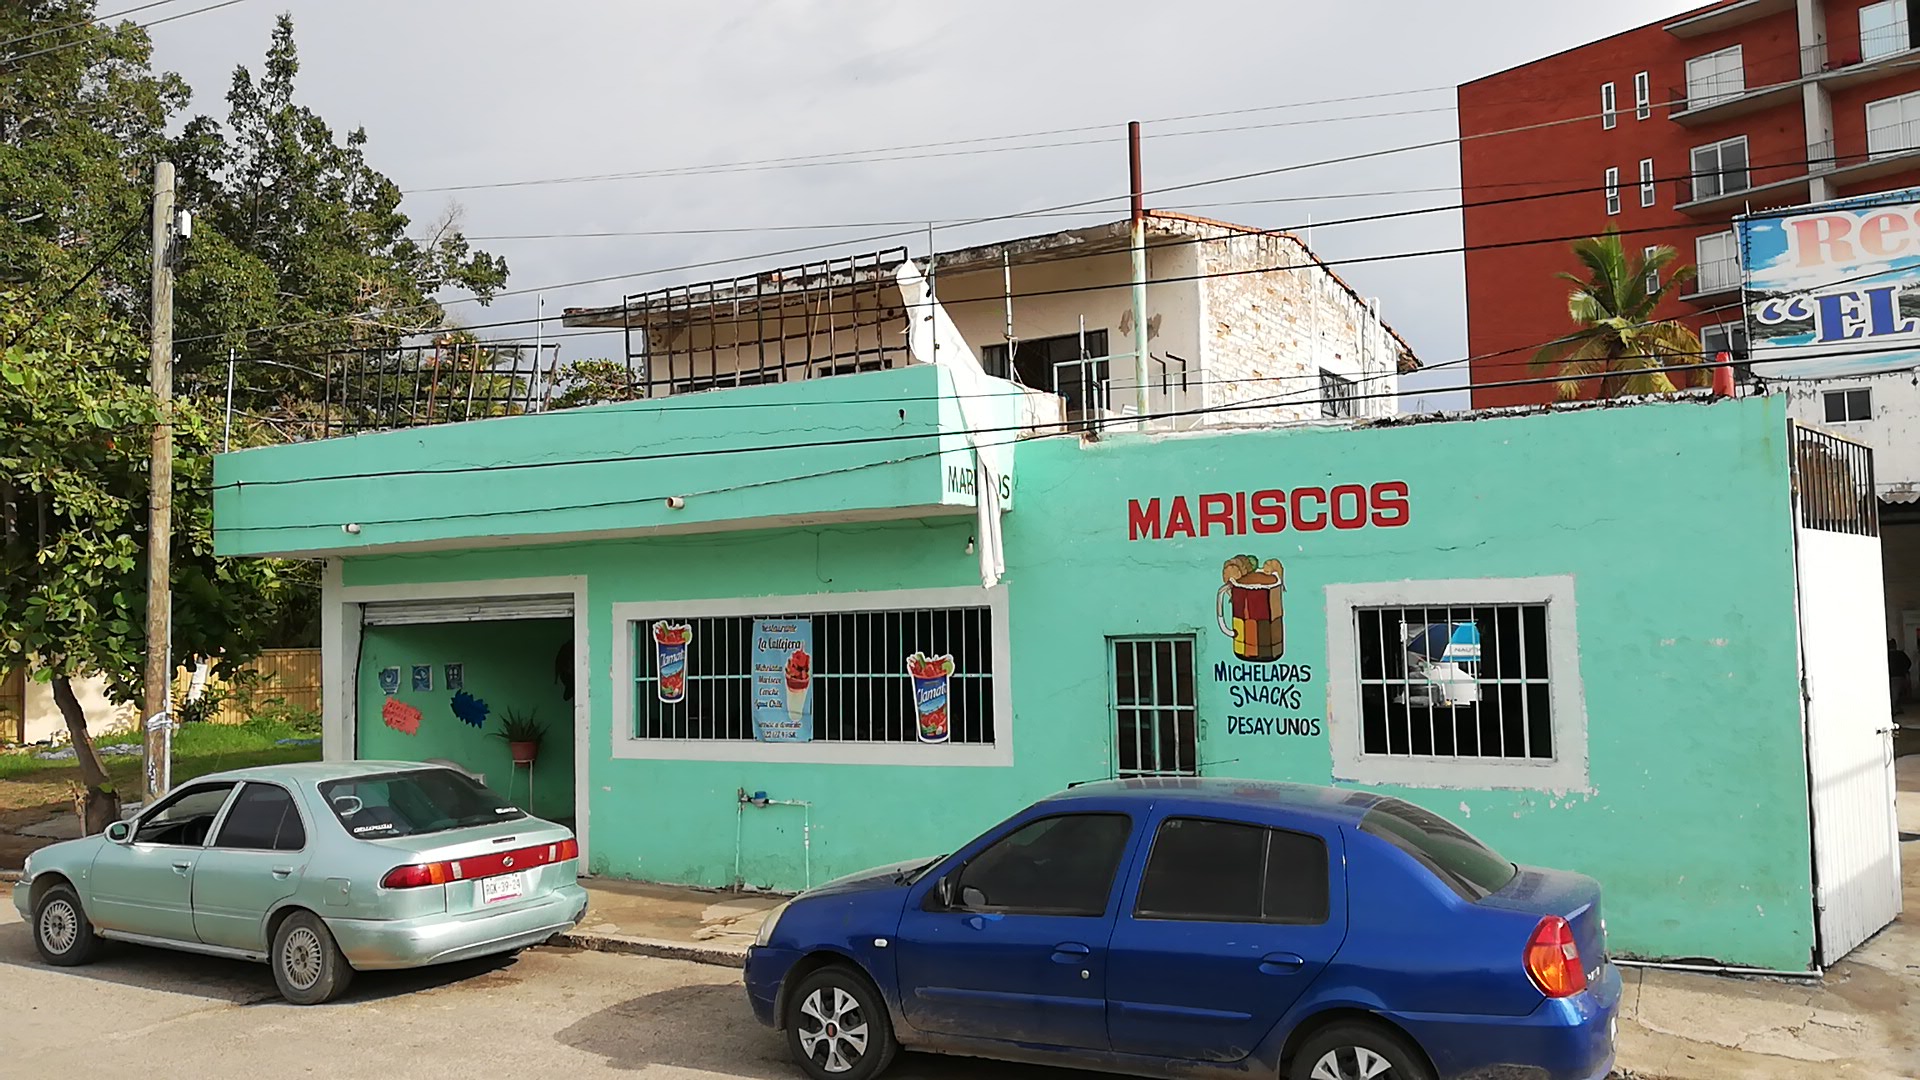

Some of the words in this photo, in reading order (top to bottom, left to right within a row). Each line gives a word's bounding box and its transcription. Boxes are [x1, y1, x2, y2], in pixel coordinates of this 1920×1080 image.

[1128, 481, 1409, 540] MARISCOS
[1214, 661, 1311, 682] MICHELADAS
[1229, 684, 1301, 709] SNACKS
[1227, 716, 1320, 736] DESAYUNOS
